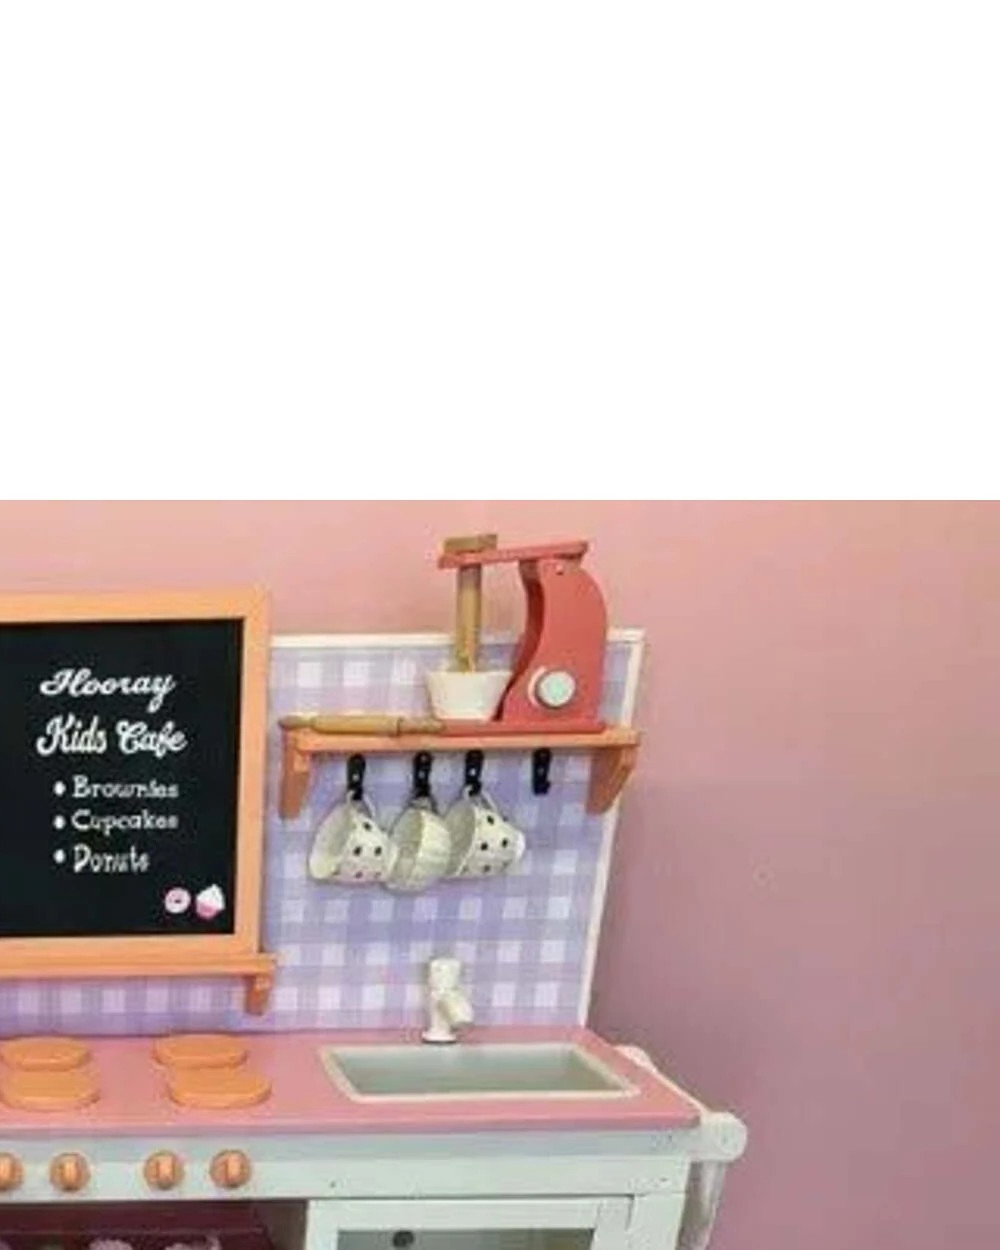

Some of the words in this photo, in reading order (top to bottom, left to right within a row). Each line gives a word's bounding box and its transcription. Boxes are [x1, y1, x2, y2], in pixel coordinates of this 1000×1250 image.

[40, 668, 176, 713] Hooray
[36, 713, 107, 756] Kids
[116, 720, 187, 759] Cafe
[72, 775, 178, 798] Brownies
[71, 809, 178, 836] Cupcakes
[74, 844, 149, 872] Donuts
